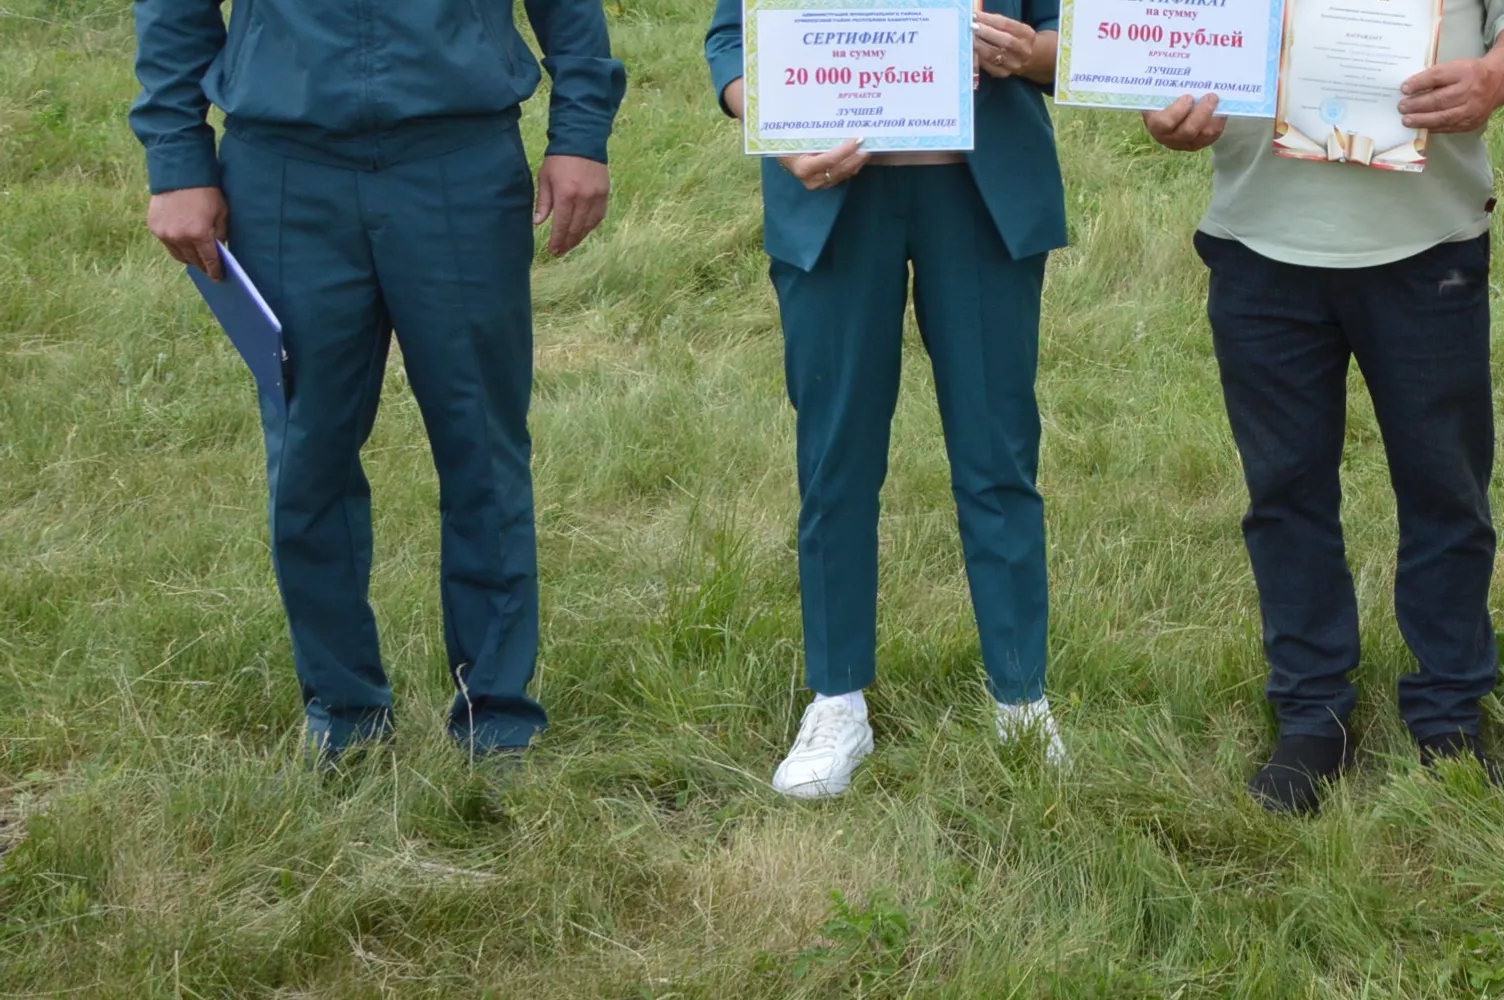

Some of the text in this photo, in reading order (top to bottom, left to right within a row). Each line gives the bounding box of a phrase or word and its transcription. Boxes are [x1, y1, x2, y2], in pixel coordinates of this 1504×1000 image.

[1145, 7, 1198, 20] на сумму
[803, 31, 919, 46] СЕРТИФИКАТ
[1097, 21, 1244, 48] 50 000 рублей
[832, 48, 886, 60] на сумму
[785, 65, 934, 88] 20 000 рублей
[1145, 64, 1191, 76] ЛУЧШЕЙ
[1070, 72, 1263, 93] ДОБРОВОЛЬНОЙ ПОЖАРНОЙ КОМАНДЕ
[836, 106, 883, 116] ЛУЧШЕЙ
[760, 116, 957, 131] ДОБРОВОЛЬНОЙ ПОЖАРНОЙ КОМАНДЕ
